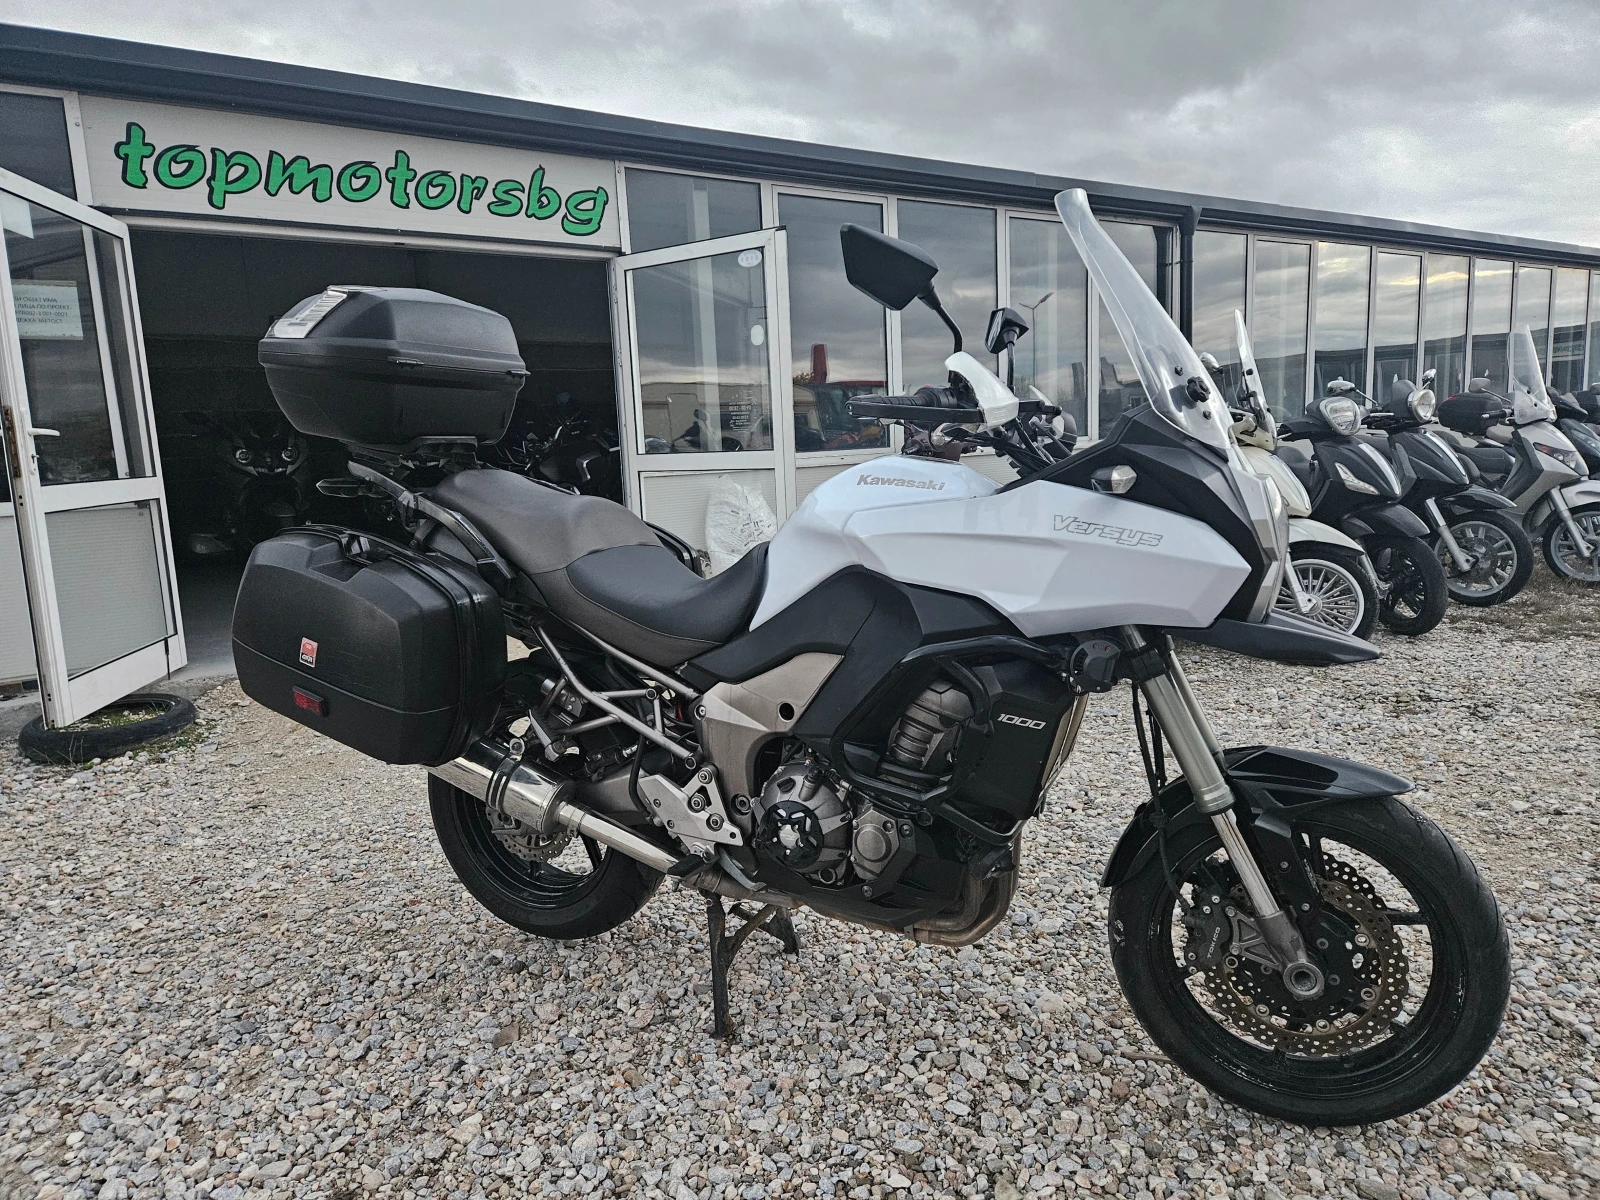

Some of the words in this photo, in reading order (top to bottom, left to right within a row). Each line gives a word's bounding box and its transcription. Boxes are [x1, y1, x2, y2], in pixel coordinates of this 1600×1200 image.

[114, 121, 609, 236] topmotorsbg
[856, 474, 946, 491] Kawasaki
[1053, 514, 1164, 547] Versys
[997, 713, 1047, 730] 1000
[1206, 926, 1221, 959] TOKICO
